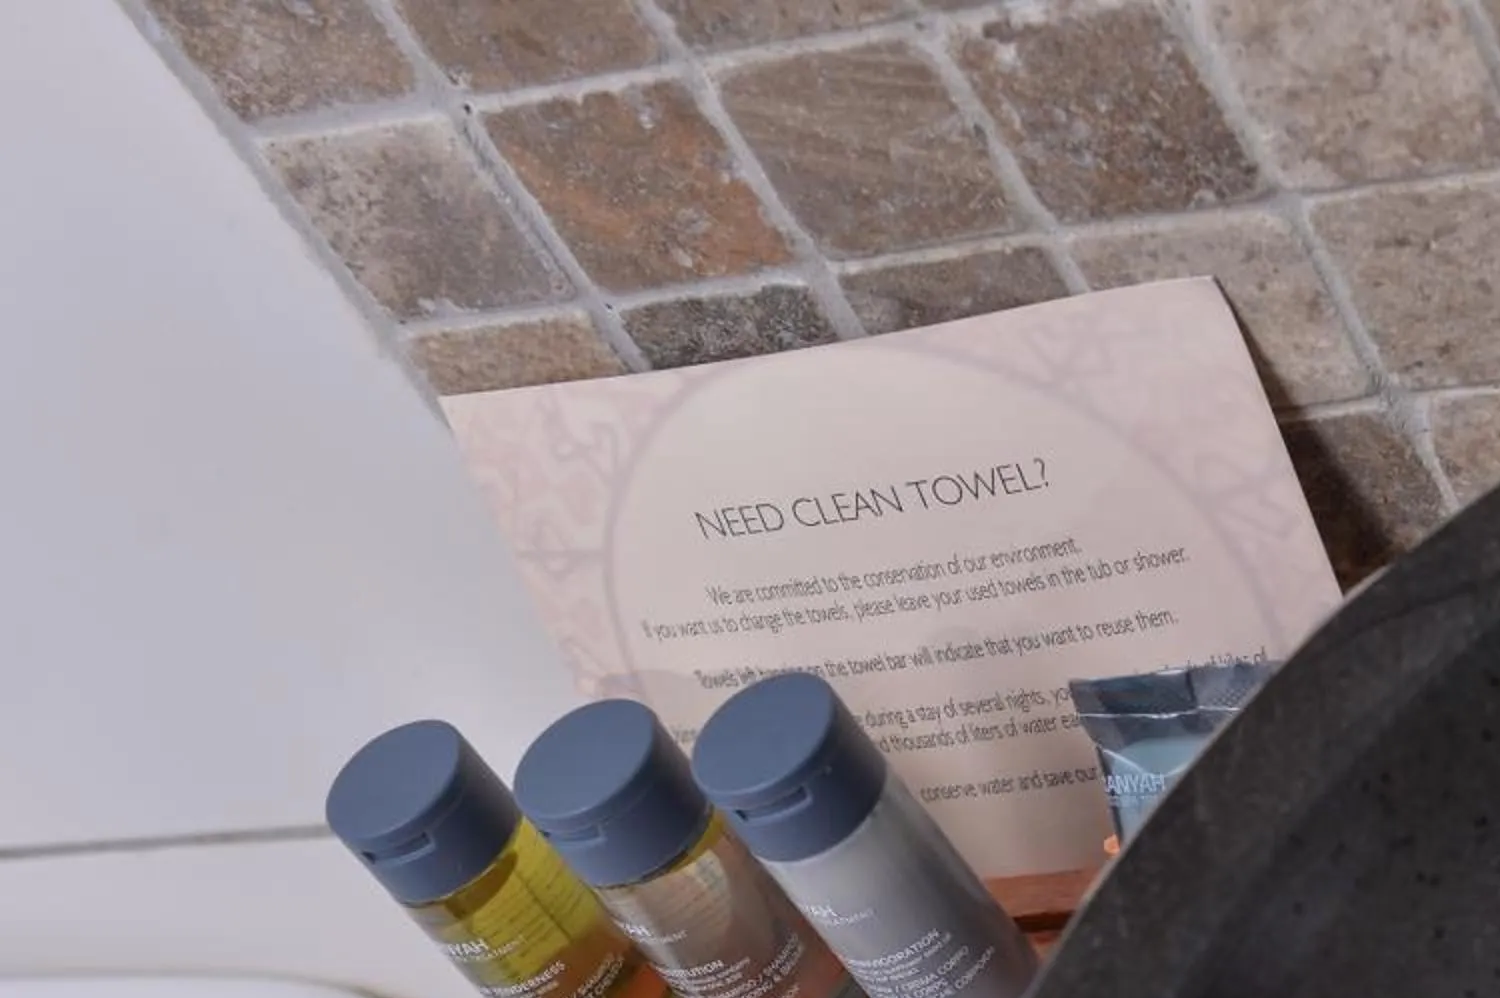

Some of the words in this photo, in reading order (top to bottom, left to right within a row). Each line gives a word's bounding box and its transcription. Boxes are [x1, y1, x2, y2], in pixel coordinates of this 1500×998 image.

[694, 503, 785, 540] NEED
[791, 484, 905, 528] CLEAN
[904, 457, 1050, 511] TOWEL?
[705, 585, 732, 605] We
[733, 589, 754, 604] are
[755, 575, 823, 602] committed
[823, 576, 838, 594] to
[838, 571, 863, 591] the
[863, 560, 945, 588] conservation
[947, 553, 961, 576] of
[963, 555, 987, 574] our
[991, 538, 1082, 568] environment.
[722, 617, 738, 632] to
[739, 611, 783, 634] change
[782, 607, 806, 626] the
[854, 598, 895, 623] please
[894, 593, 932, 612] leave
[931, 588, 963, 612] your
[965, 579, 998, 601] used
[998, 573, 1047, 597] towels
[1048, 571, 1062, 588] in
[1061, 565, 1087, 585] the
[1089, 559, 1113, 580] tub
[1114, 557, 1130, 575] or
[1132, 547, 1191, 573] shower.
[693, 668, 739, 689] Towels
[824, 659, 849, 677] the
[848, 651, 886, 675] towel
[886, 651, 908, 671] bar
[910, 646, 935, 667] will
[935, 641, 985, 663] indicate
[984, 636, 1011, 656] that
[1012, 635, 1040, 657] you
[1040, 626, 1080, 648] want
[1078, 622, 1094, 642] to
[1096, 615, 1135, 638] reuse
[1135, 608, 1179, 630] them.
[893, 731, 955, 752] thousands
[955, 723, 969, 744] of
[971, 720, 1003, 743] liters
[1005, 715, 1018, 737] of
[1022, 714, 1056, 736] water
[943, 696, 957, 719] of
[959, 692, 1003, 717] several
[920, 782, 977, 804] conserve
[980, 776, 1014, 797] water
[1018, 768, 1043, 791] and
[1042, 770, 1075, 789] save
[1075, 765, 1098, 785] our
